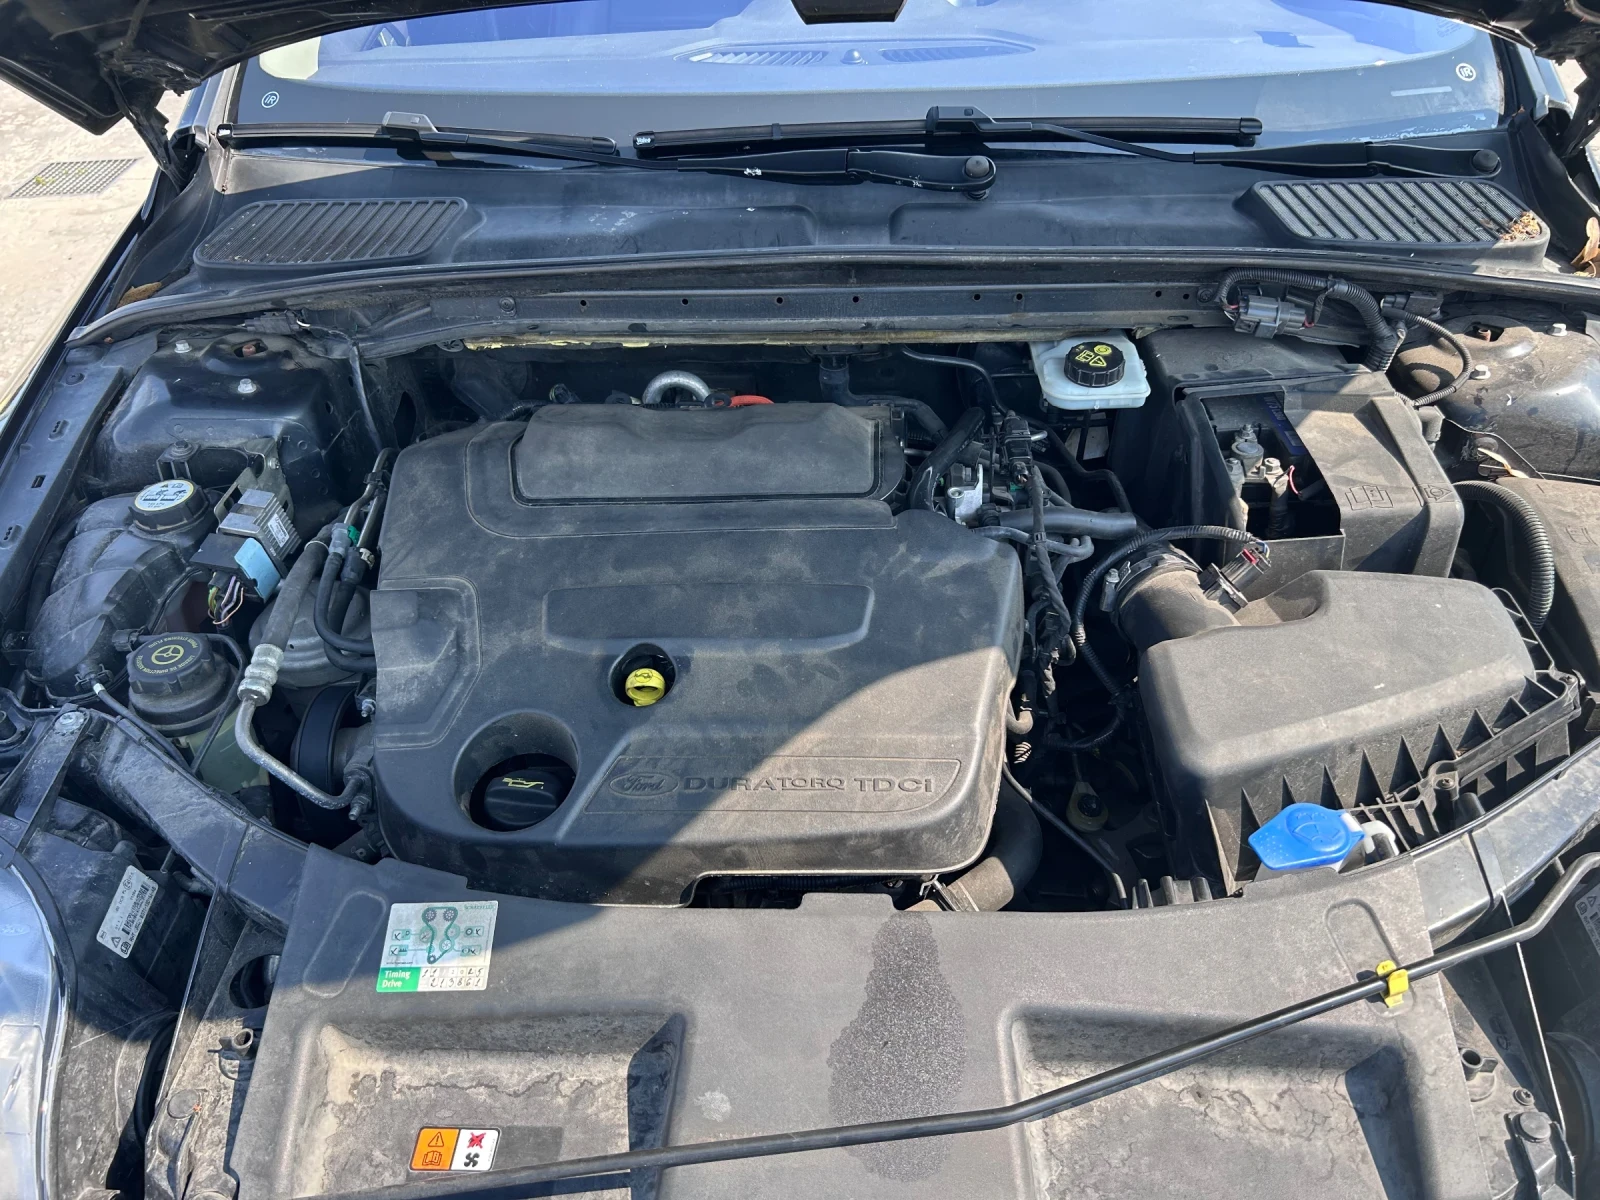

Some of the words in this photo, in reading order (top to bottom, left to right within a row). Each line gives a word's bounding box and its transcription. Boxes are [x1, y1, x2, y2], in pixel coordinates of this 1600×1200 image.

[622, 774, 668, 793] Ford
[684, 776, 846, 793] DURATORQ
[853, 777, 934, 794] TDCi
[384, 970, 412, 979] Timing
[381, 980, 403, 988] Drive
